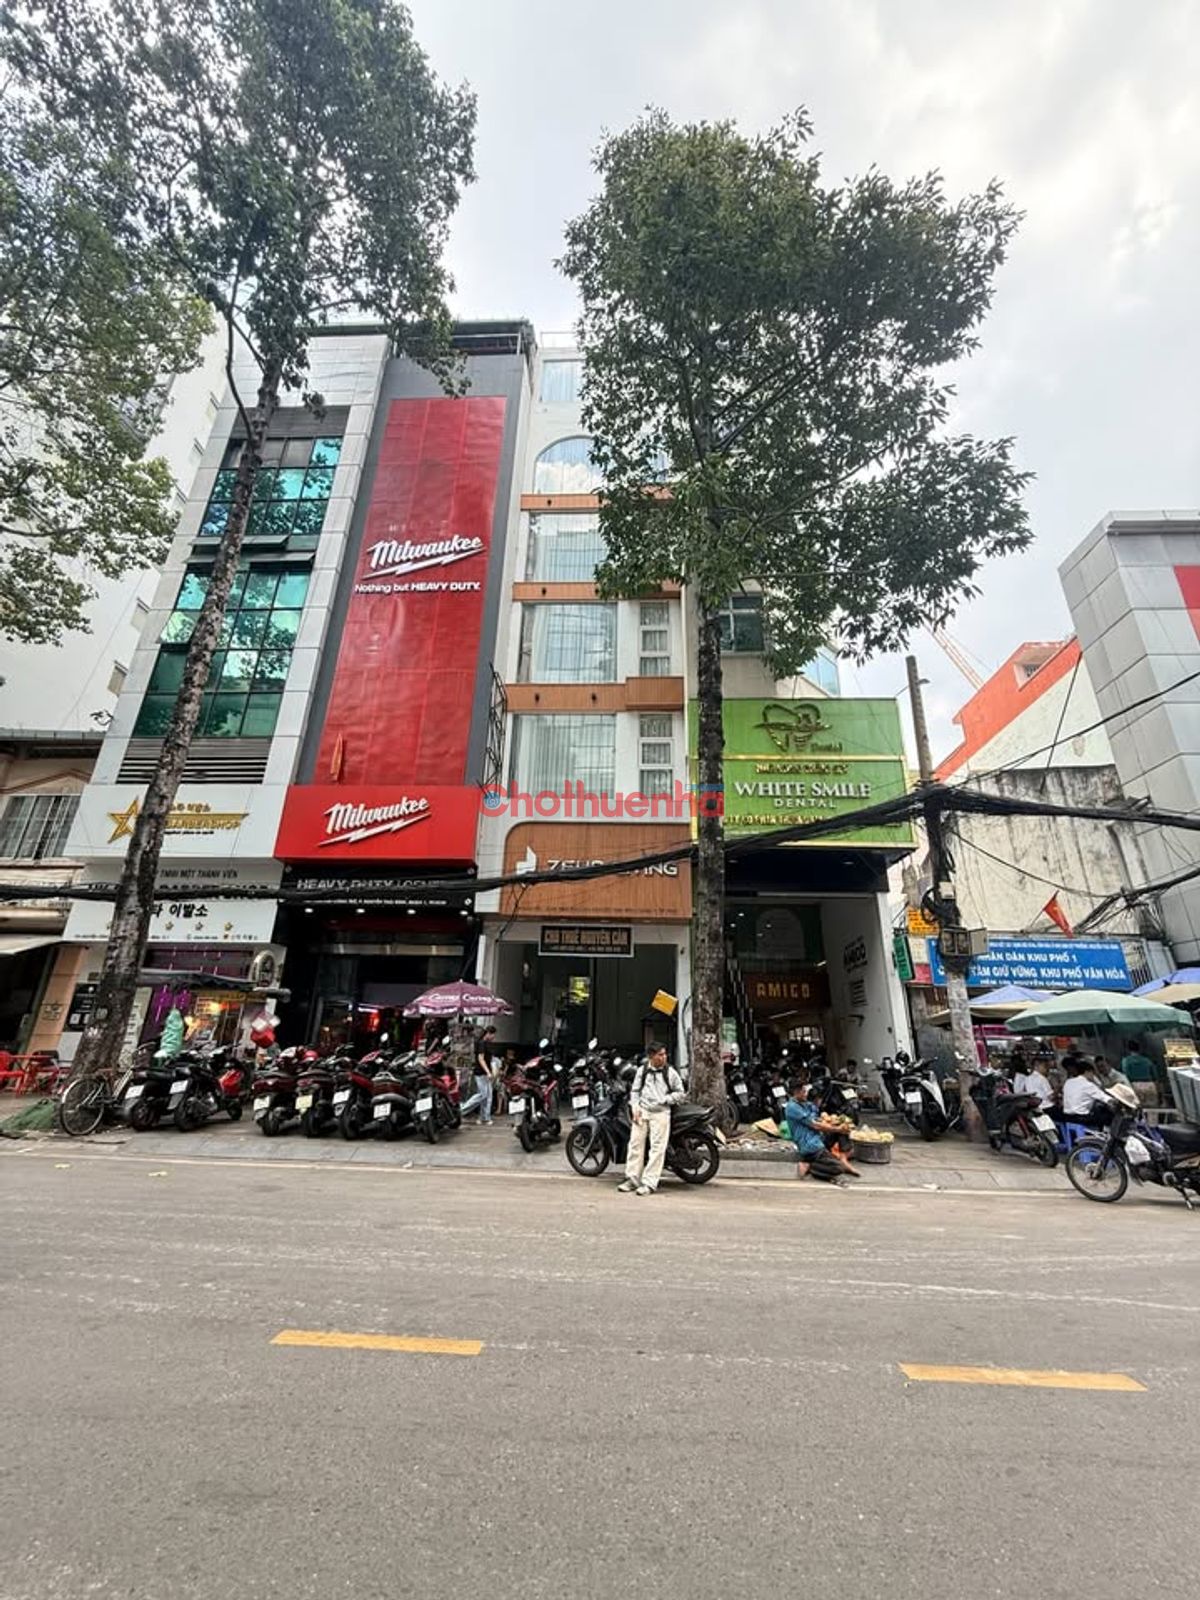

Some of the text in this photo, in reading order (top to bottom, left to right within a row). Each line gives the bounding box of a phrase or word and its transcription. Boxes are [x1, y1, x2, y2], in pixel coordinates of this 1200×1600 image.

[367, 535, 484, 570] Milwaukee
[355, 583, 391, 594] Nothing
[394, 583, 409, 592] but
[411, 582, 449, 591] HEAVY
[735, 782, 872, 799] WHITE SMILE
[774, 799, 837, 809] DENTAL
[323, 796, 430, 834] Milwaukee
[296, 879, 348, 890] HEAVY
[169, 903, 208, 918] 이발소
[1027, 952, 1047, 962] KHU
[1050, 951, 1070, 962] PHỐ
[1040, 967, 1060, 978] KHU
[1062, 966, 1082, 979] PHỐ
[756, 982, 810, 998] AMICO
